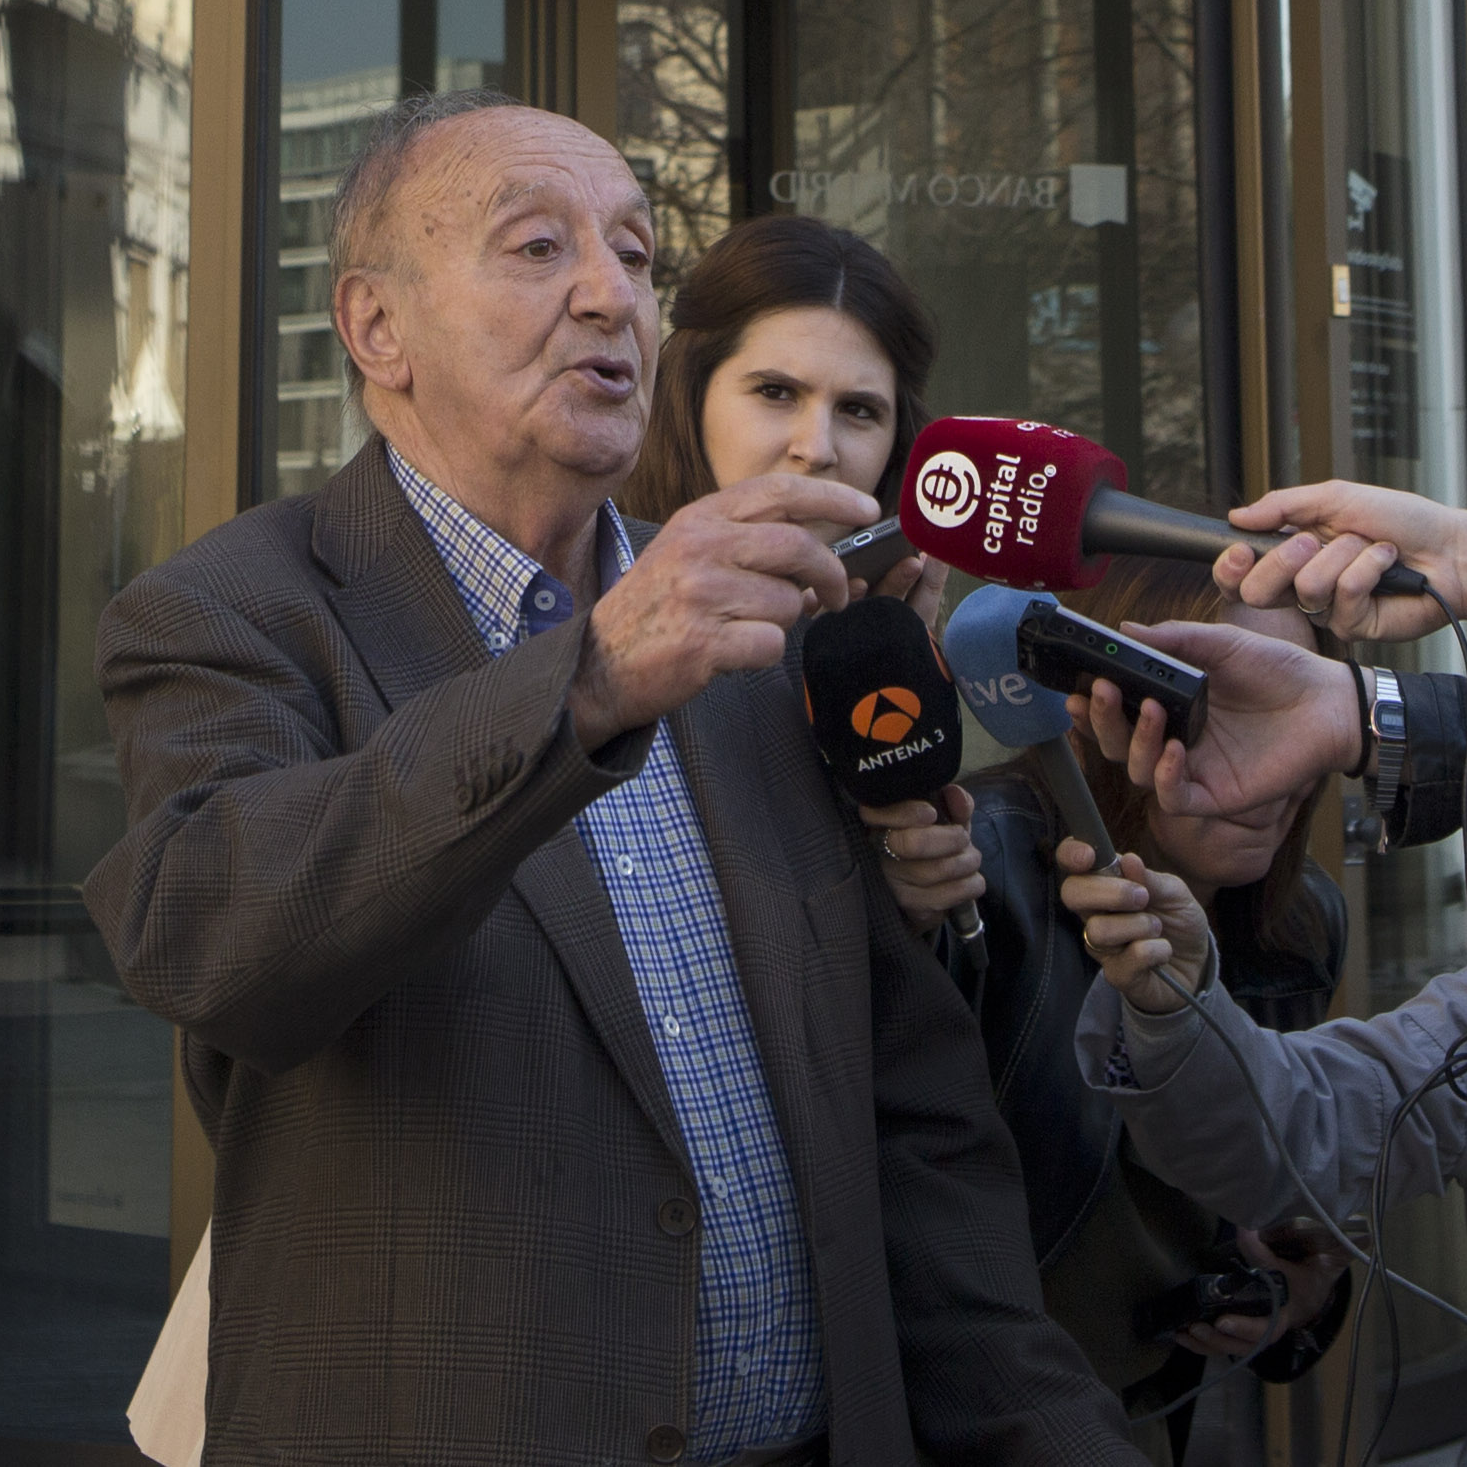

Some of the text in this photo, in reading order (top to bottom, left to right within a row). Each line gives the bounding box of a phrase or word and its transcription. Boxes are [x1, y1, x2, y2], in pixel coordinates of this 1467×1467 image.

[983, 453, 1022, 554] capital
[1016, 472, 1049, 546] radio
[958, 673, 1033, 708] tve
[858, 728, 945, 772] ANTENA 3
